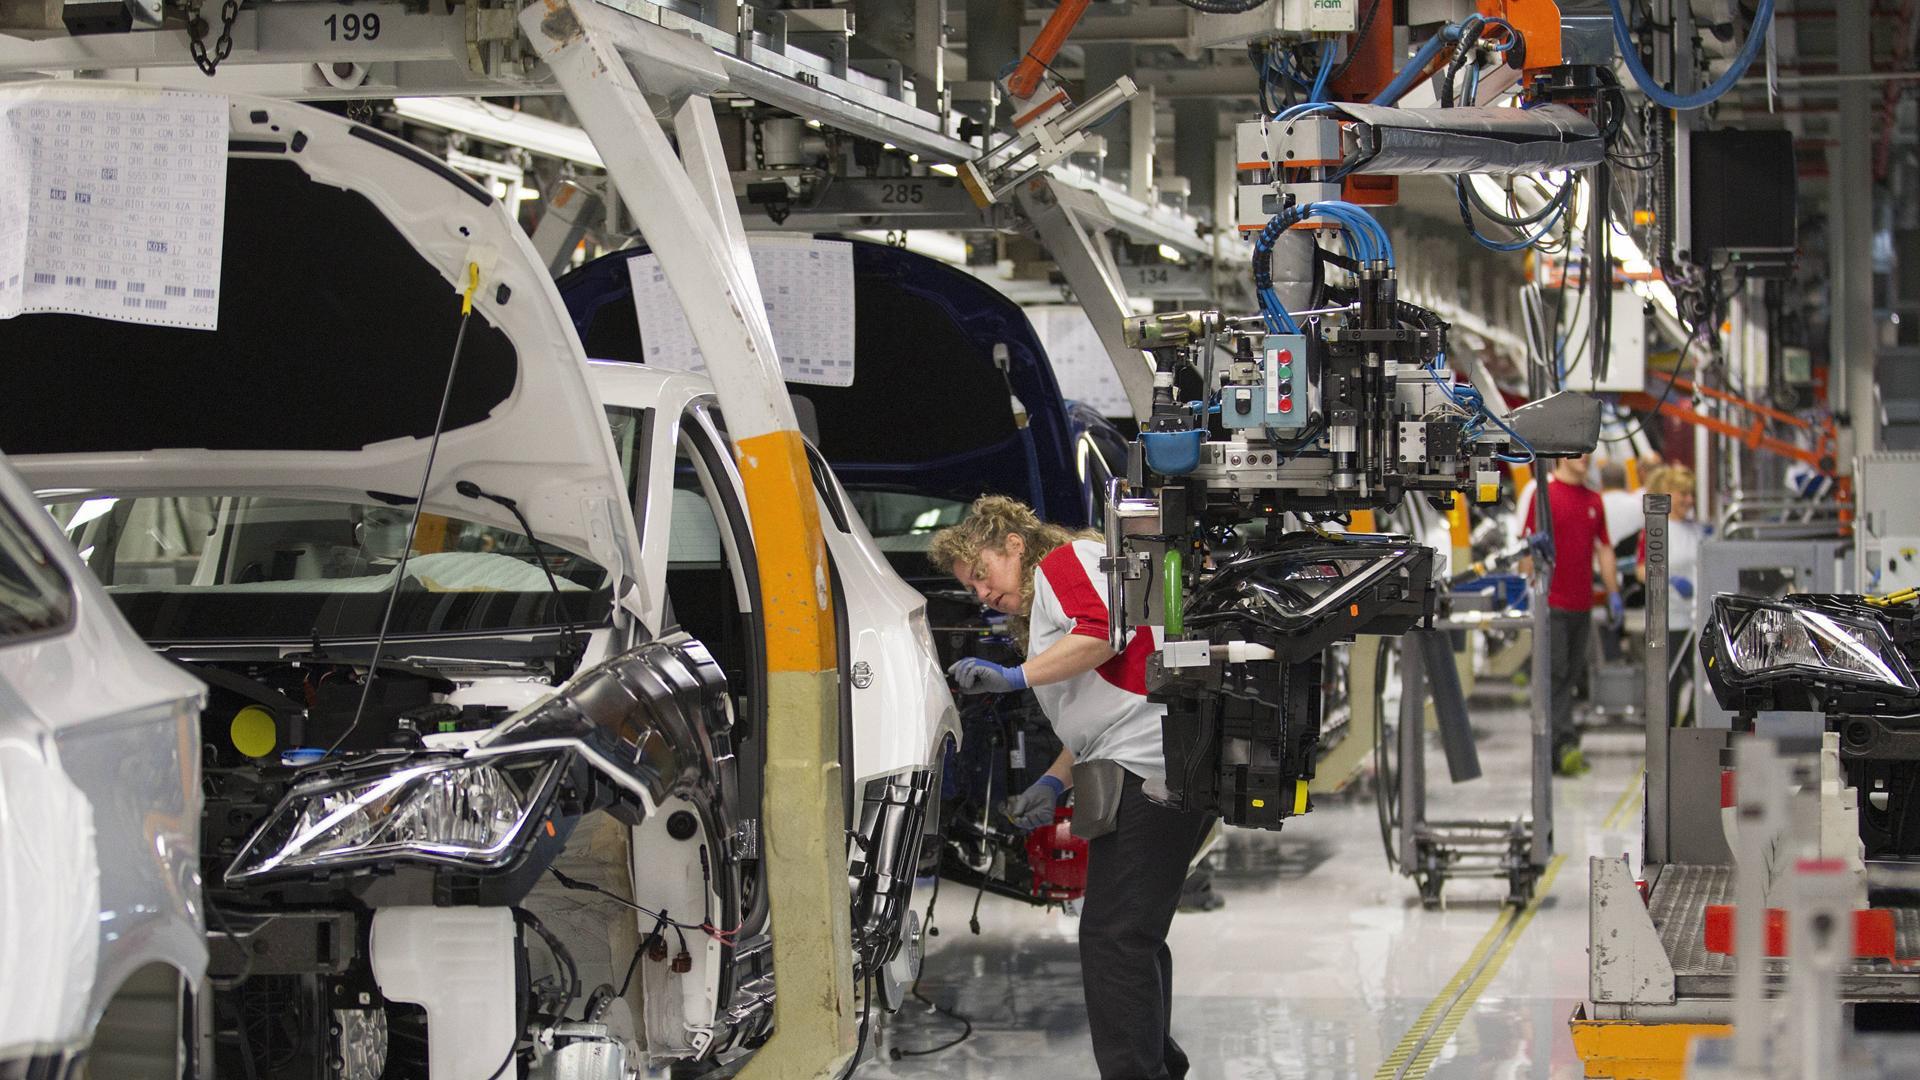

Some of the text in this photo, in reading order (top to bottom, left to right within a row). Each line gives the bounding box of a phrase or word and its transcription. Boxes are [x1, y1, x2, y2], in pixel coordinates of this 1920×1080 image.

[324, 13, 381, 42] 199
[881, 183, 924, 204] 285
[1138, 268, 1168, 285] 134
